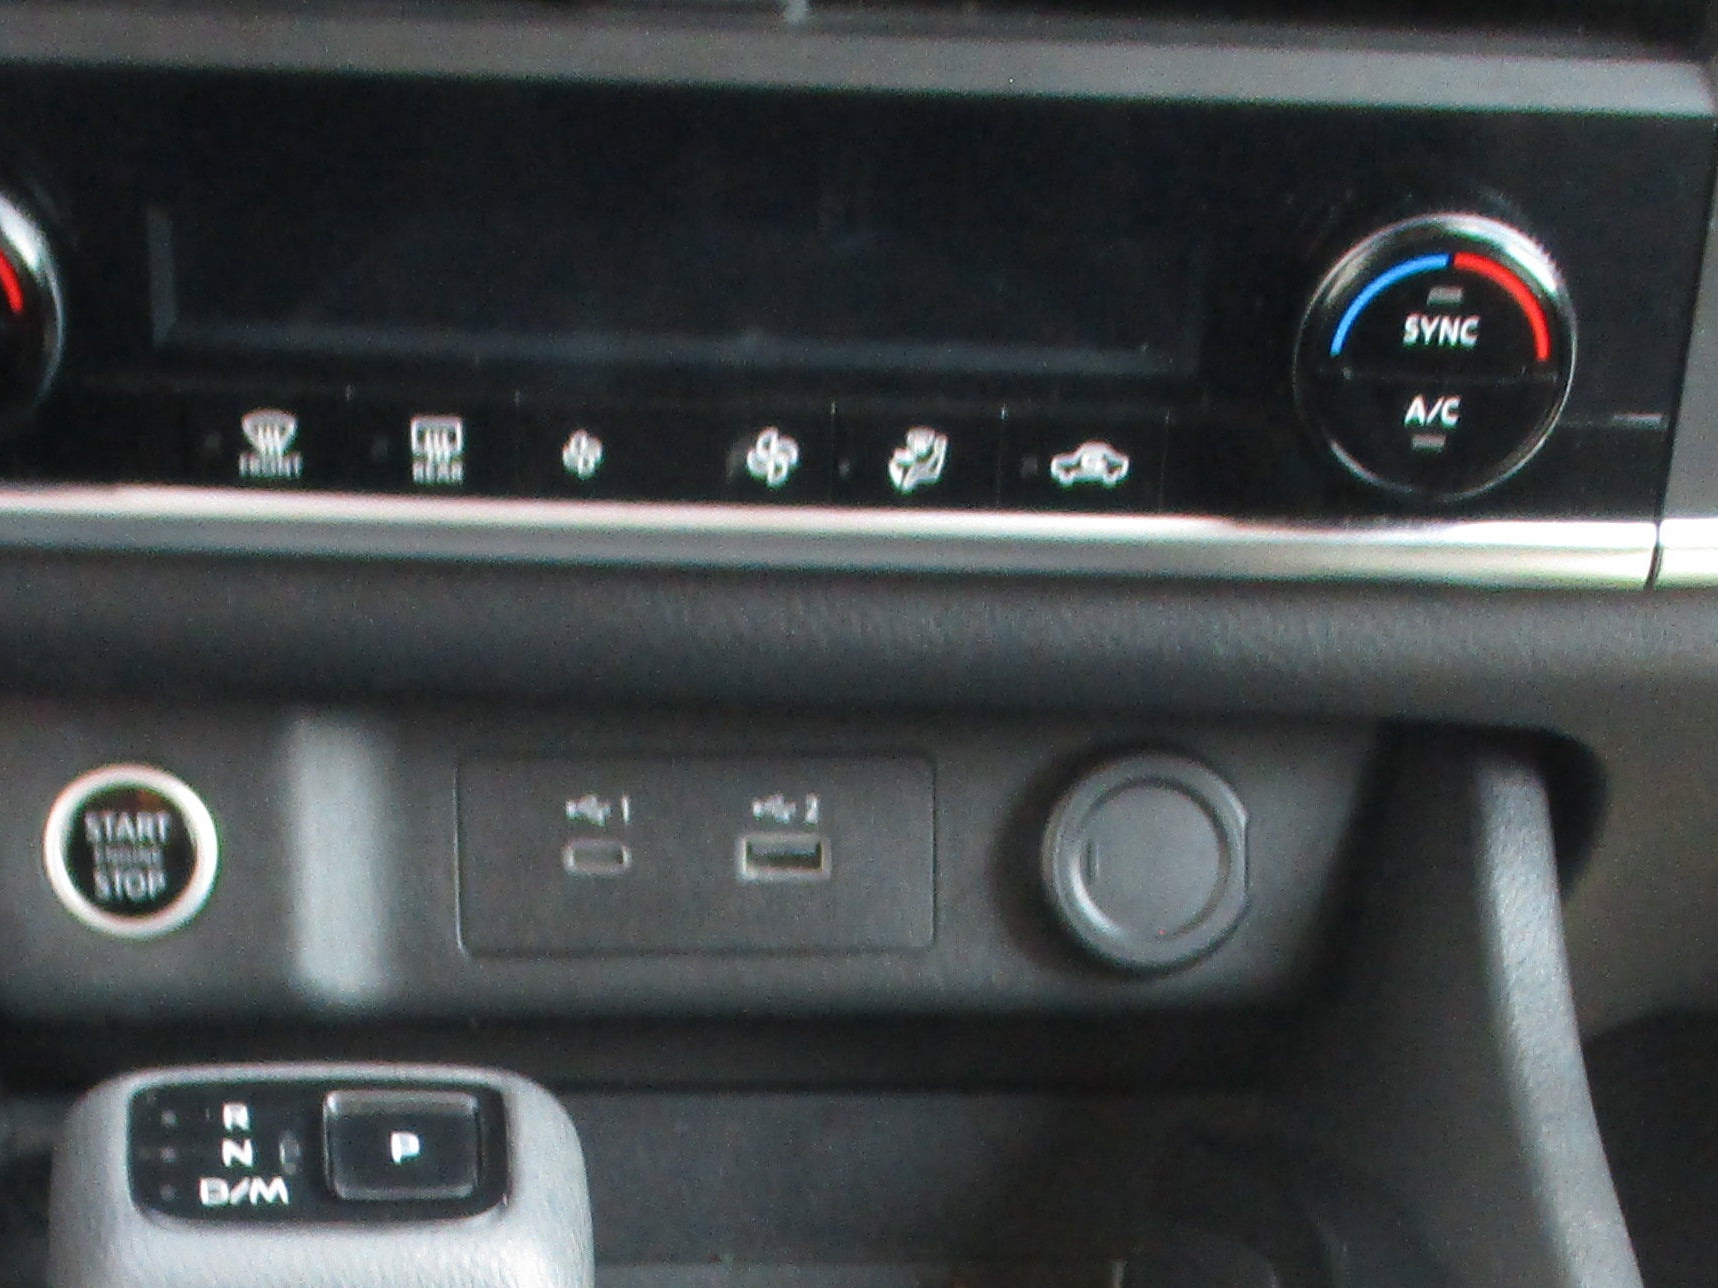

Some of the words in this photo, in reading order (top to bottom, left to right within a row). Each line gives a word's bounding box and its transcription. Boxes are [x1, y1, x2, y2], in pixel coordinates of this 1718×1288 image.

[1402, 313, 1481, 348] SYNC
[1404, 395, 1461, 428] A/C
[221, 1137, 253, 1168] N
[390, 1130, 421, 1164] P
[199, 1175, 290, 1207] D/M
